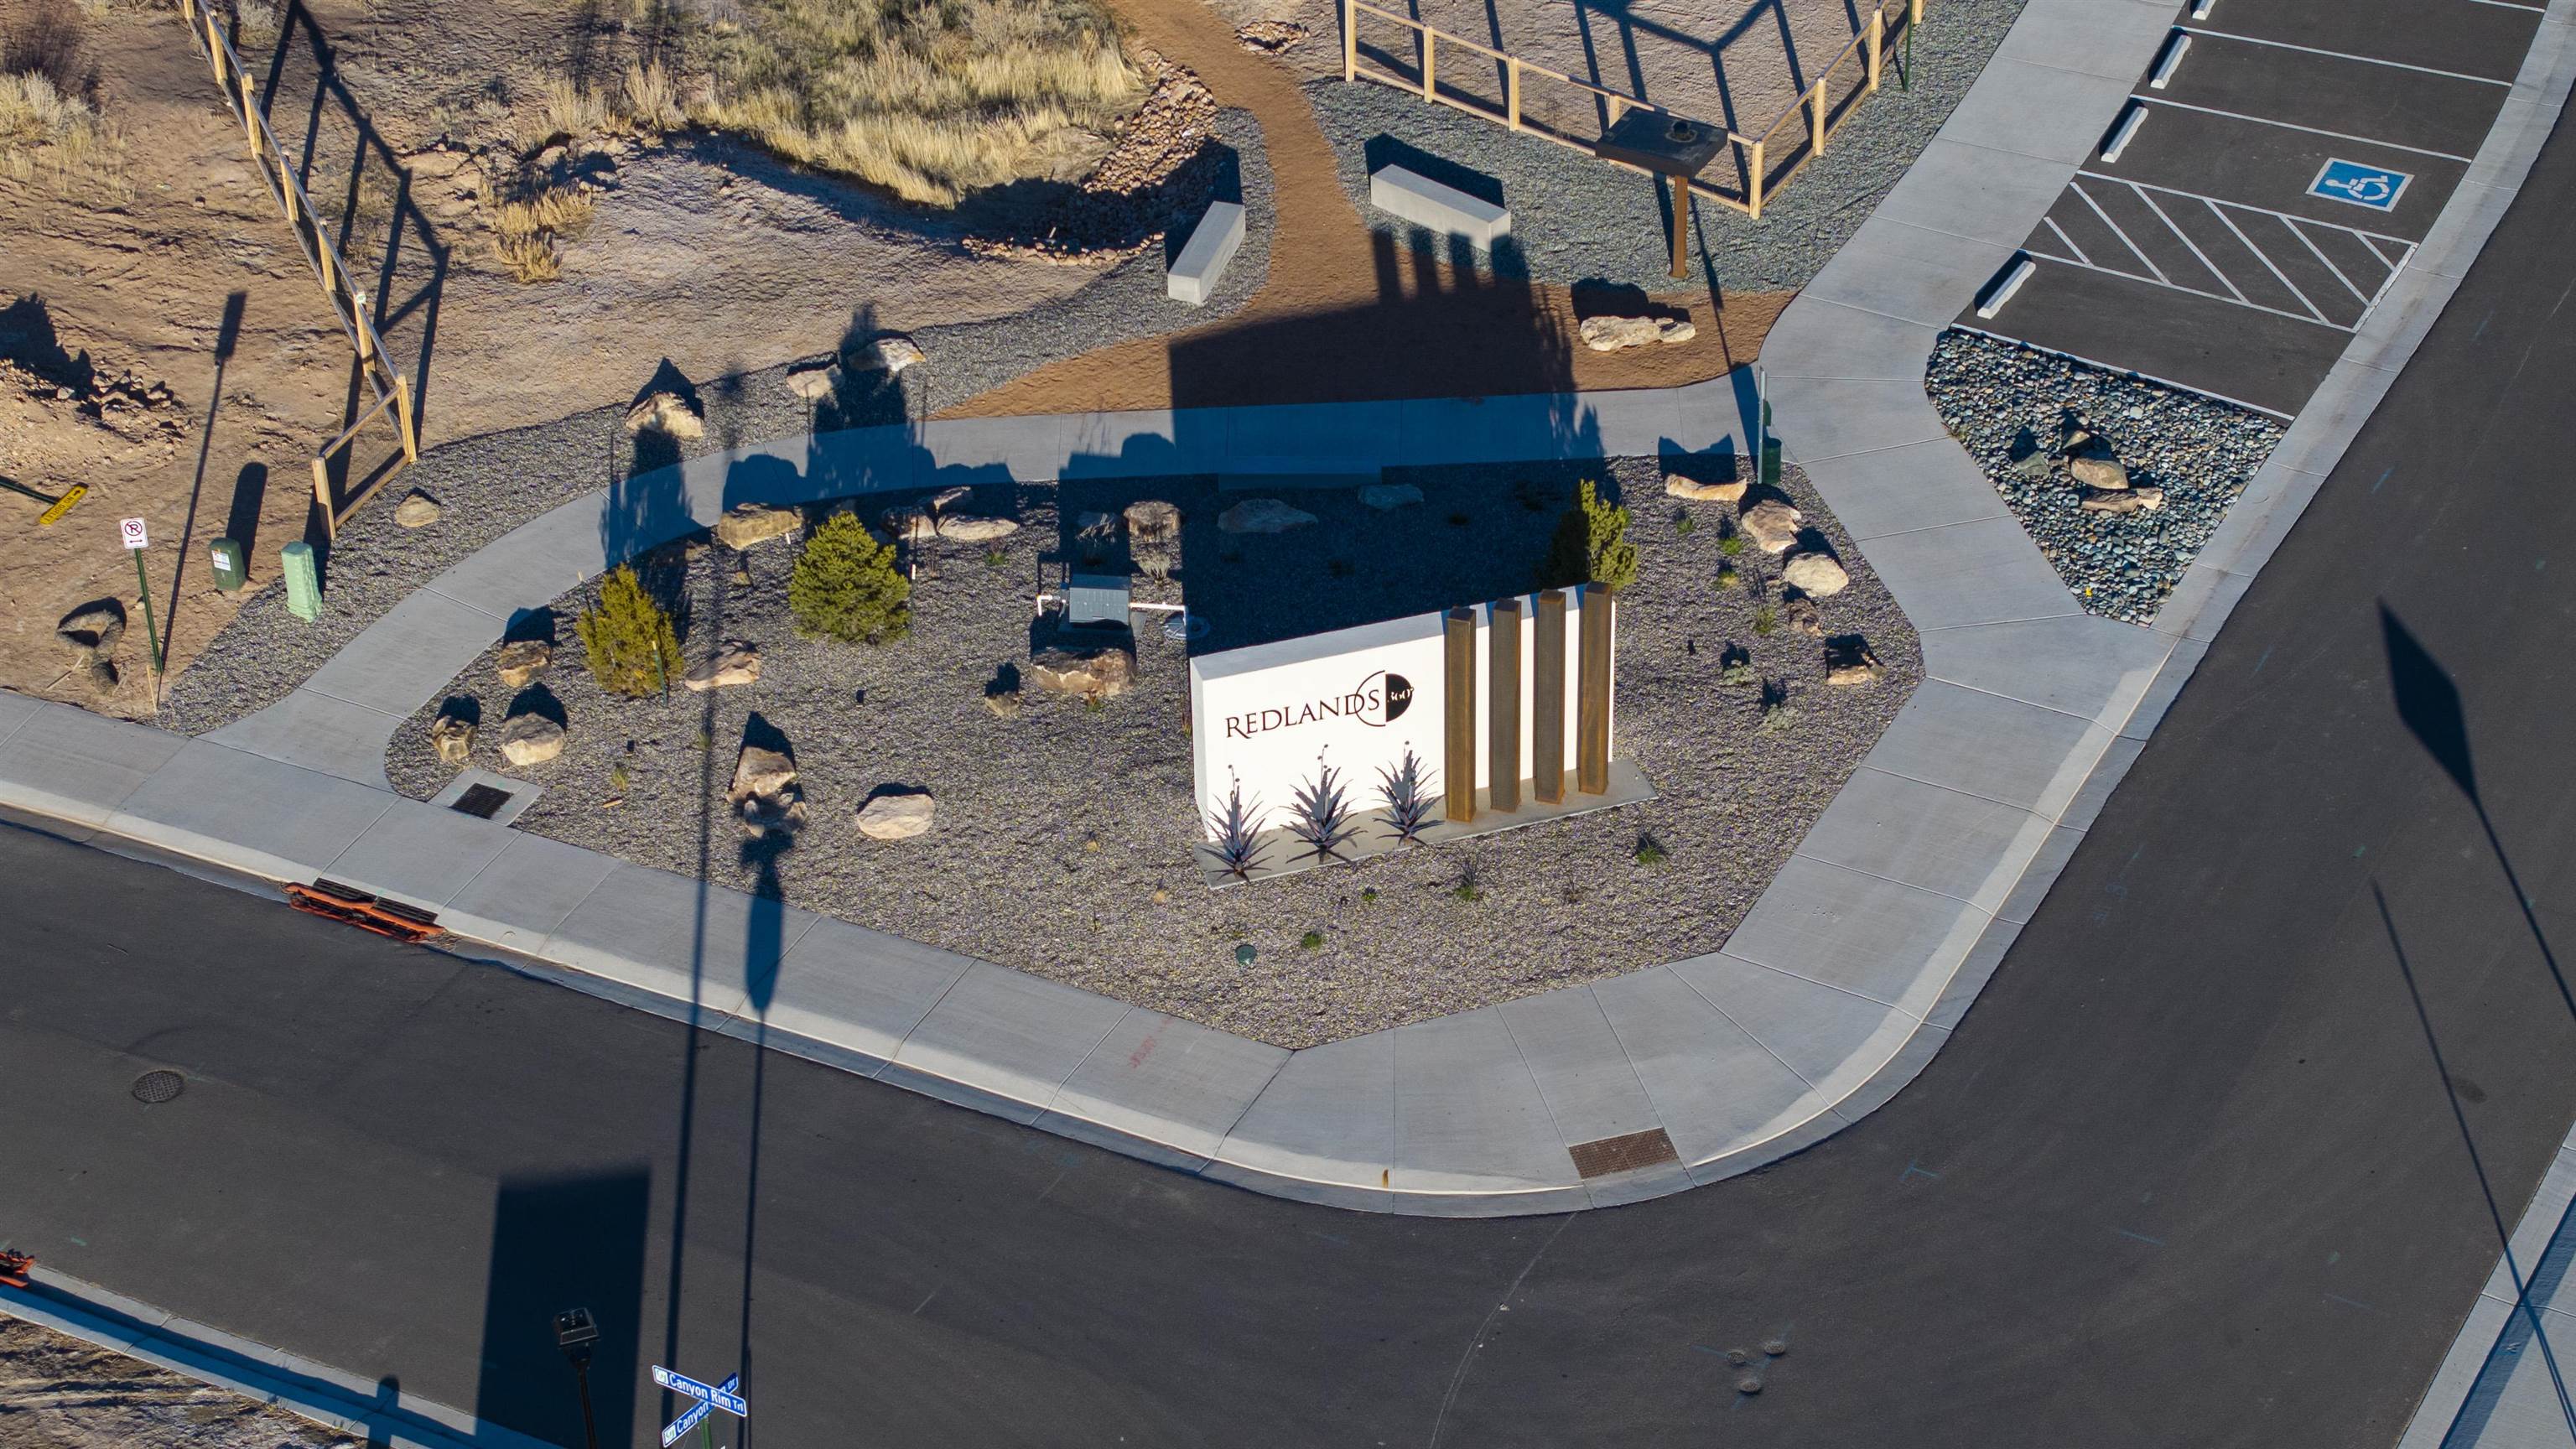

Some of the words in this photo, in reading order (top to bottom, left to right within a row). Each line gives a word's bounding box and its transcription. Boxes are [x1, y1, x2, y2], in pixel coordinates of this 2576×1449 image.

[1224, 688, 1379, 739] REDLANDS
[669, 1374, 708, 1399] Canyon
[710, 1389, 731, 1408] Rim
[677, 1401, 709, 1433] Canyon
